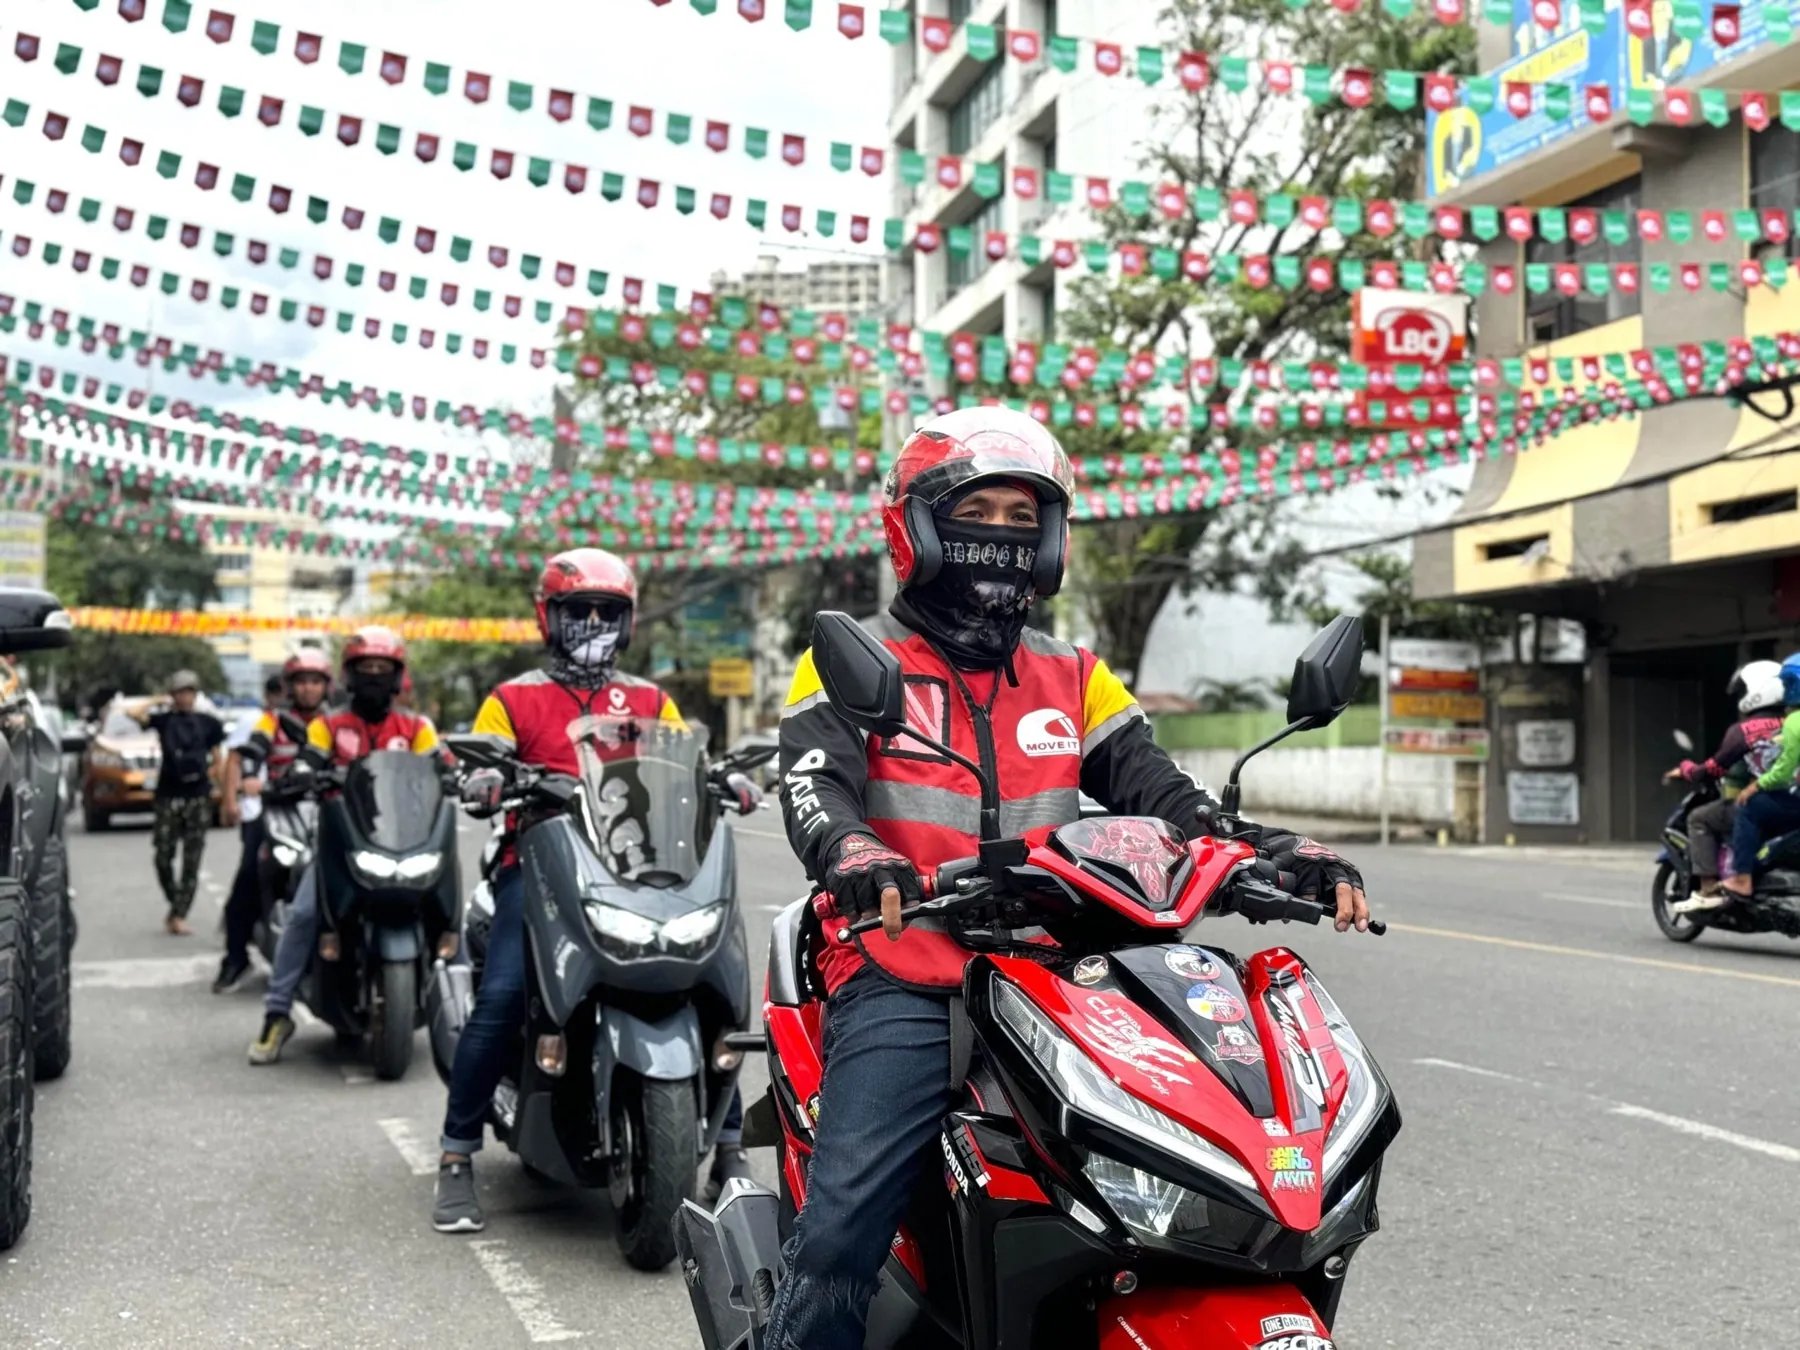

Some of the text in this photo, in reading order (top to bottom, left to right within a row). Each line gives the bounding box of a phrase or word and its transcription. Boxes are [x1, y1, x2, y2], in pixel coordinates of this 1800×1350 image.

[1026, 741, 1078, 751] MOVE IT
[1115, 1007, 1142, 1031] HONDA
[941, 1131, 969, 1197] HONDA
[952, 1124, 992, 1188] 125i
[1264, 1157, 1313, 1171] GRIND
[1266, 1146, 1304, 1159] DAILY
[1272, 1170, 1317, 1194] AWIT
[1116, 1315, 1138, 1340] Combi
[1264, 1317, 1283, 1332] ONE
